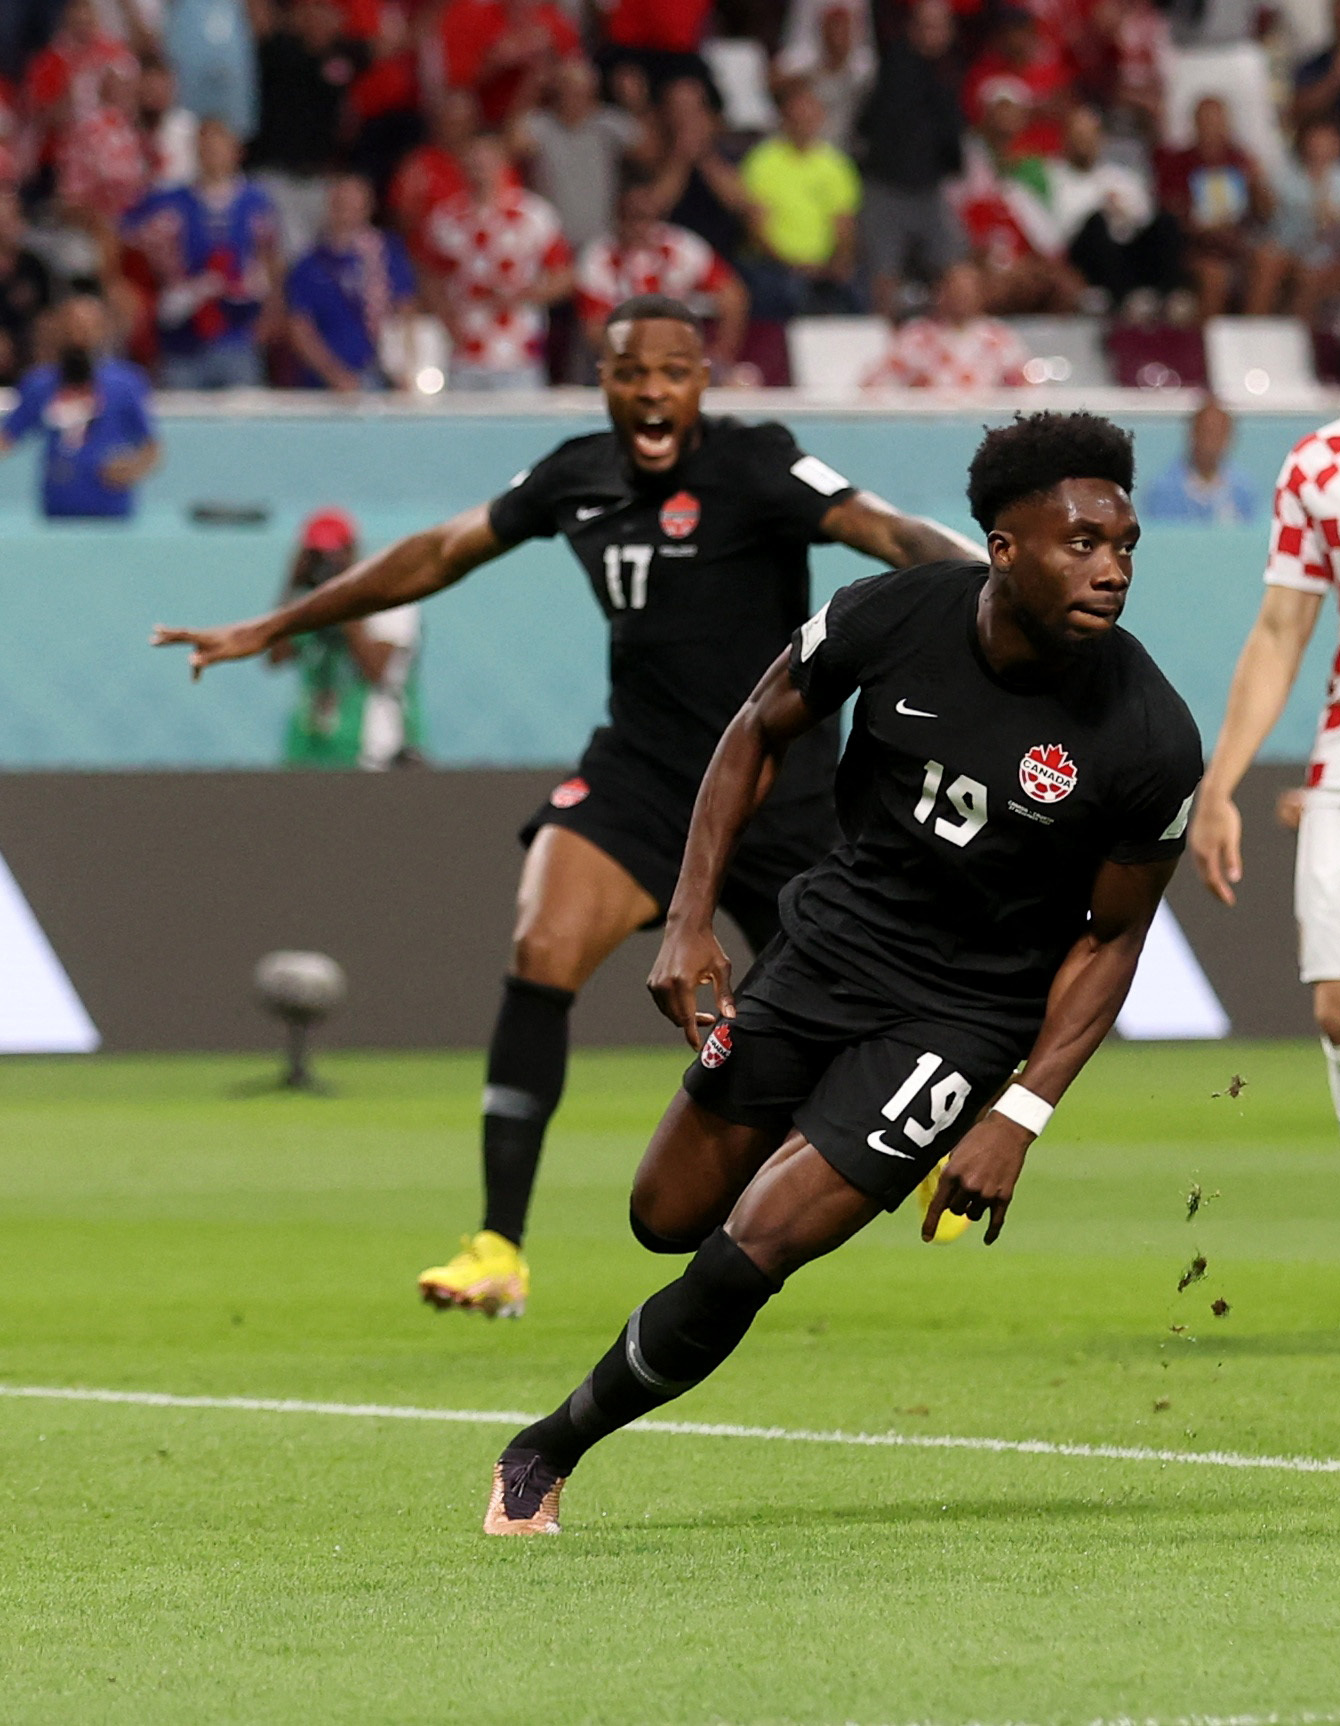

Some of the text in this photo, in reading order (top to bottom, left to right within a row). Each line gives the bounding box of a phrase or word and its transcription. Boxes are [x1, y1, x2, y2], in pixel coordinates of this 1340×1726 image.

[604, 543, 653, 609] 17
[913, 759, 988, 848] 19
[1023, 759, 1071, 788] CANADA
[881, 1051, 972, 1147] 19
